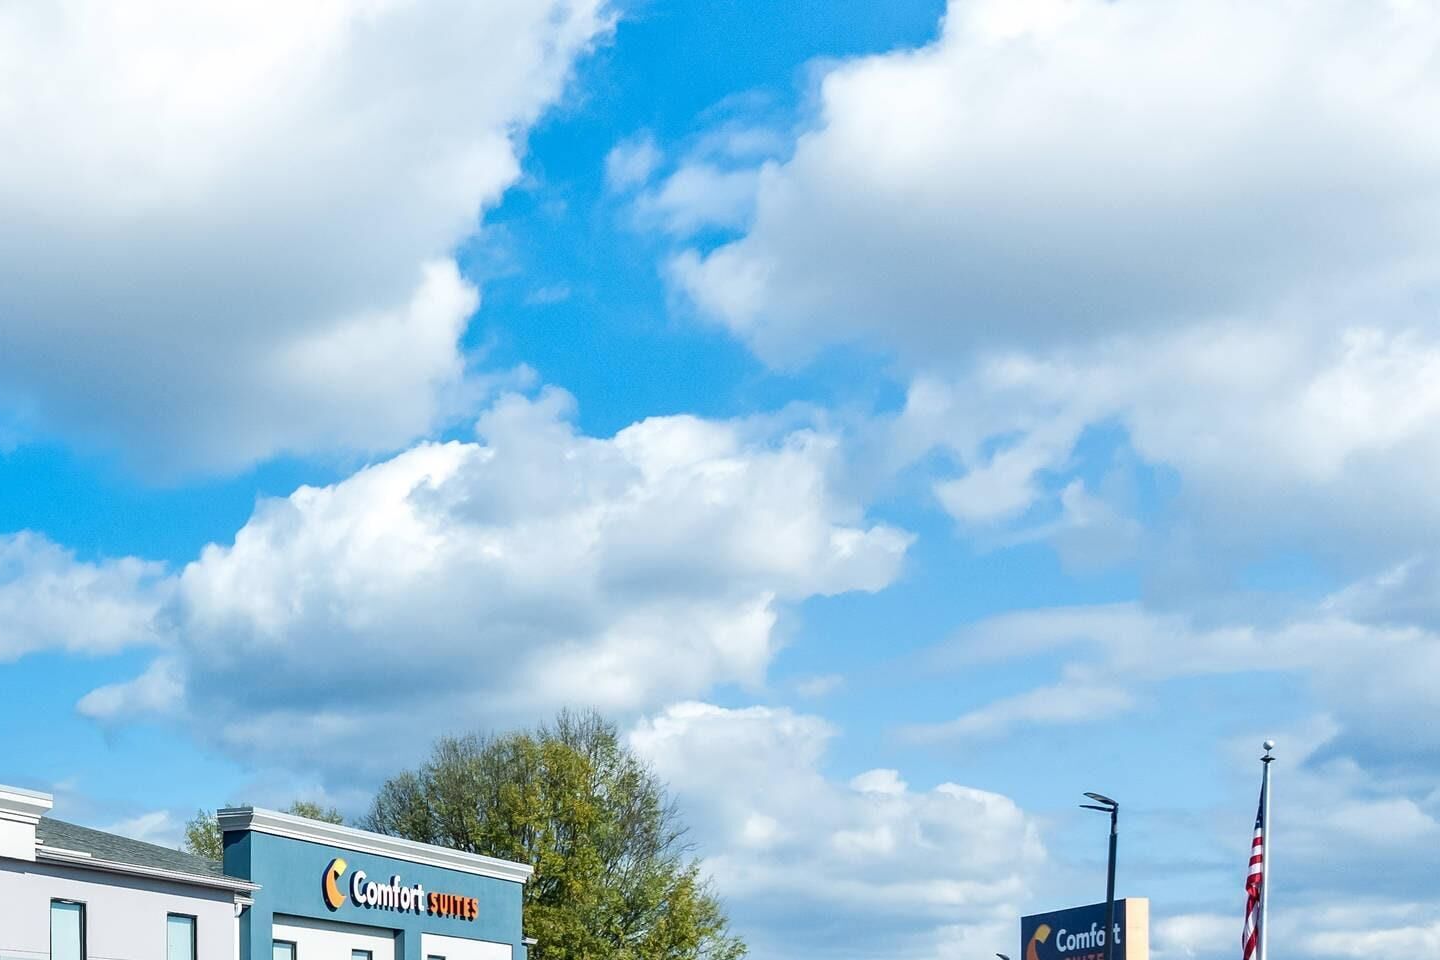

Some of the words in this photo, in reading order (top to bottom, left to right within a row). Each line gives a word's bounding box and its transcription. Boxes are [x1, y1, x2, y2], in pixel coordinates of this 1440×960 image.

[353, 870, 425, 911] Comfort
[430, 892, 479, 919] SUITES
[1056, 922, 1121, 952] Comfot
